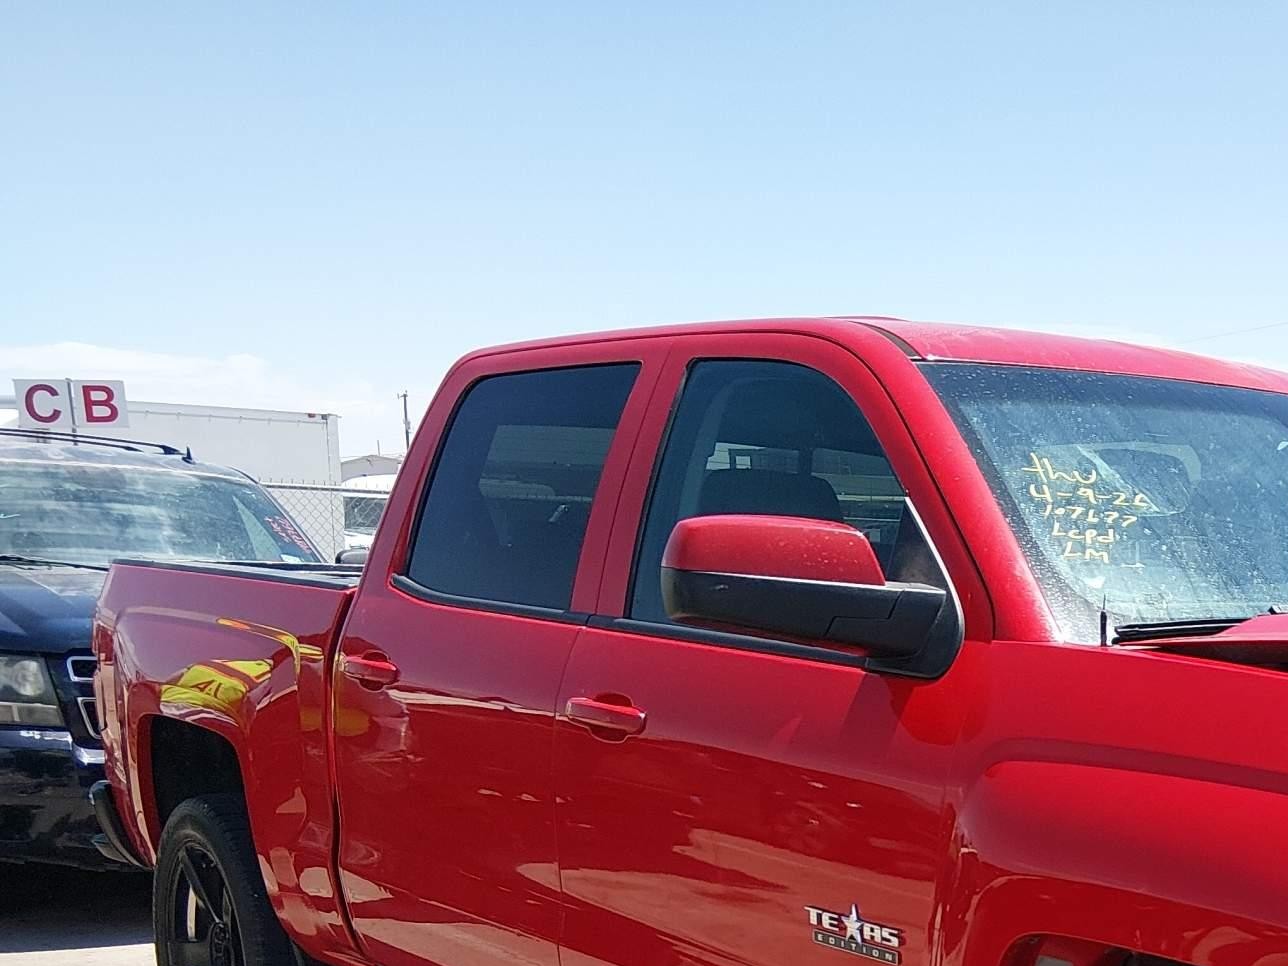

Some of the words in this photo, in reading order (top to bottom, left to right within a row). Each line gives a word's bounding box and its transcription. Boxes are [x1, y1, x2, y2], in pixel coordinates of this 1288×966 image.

[24, 384, 62, 424] C
[81, 385, 119, 424] B
[803, 904, 899, 948] TEXAS
[816, 933, 893, 961] EDITION
